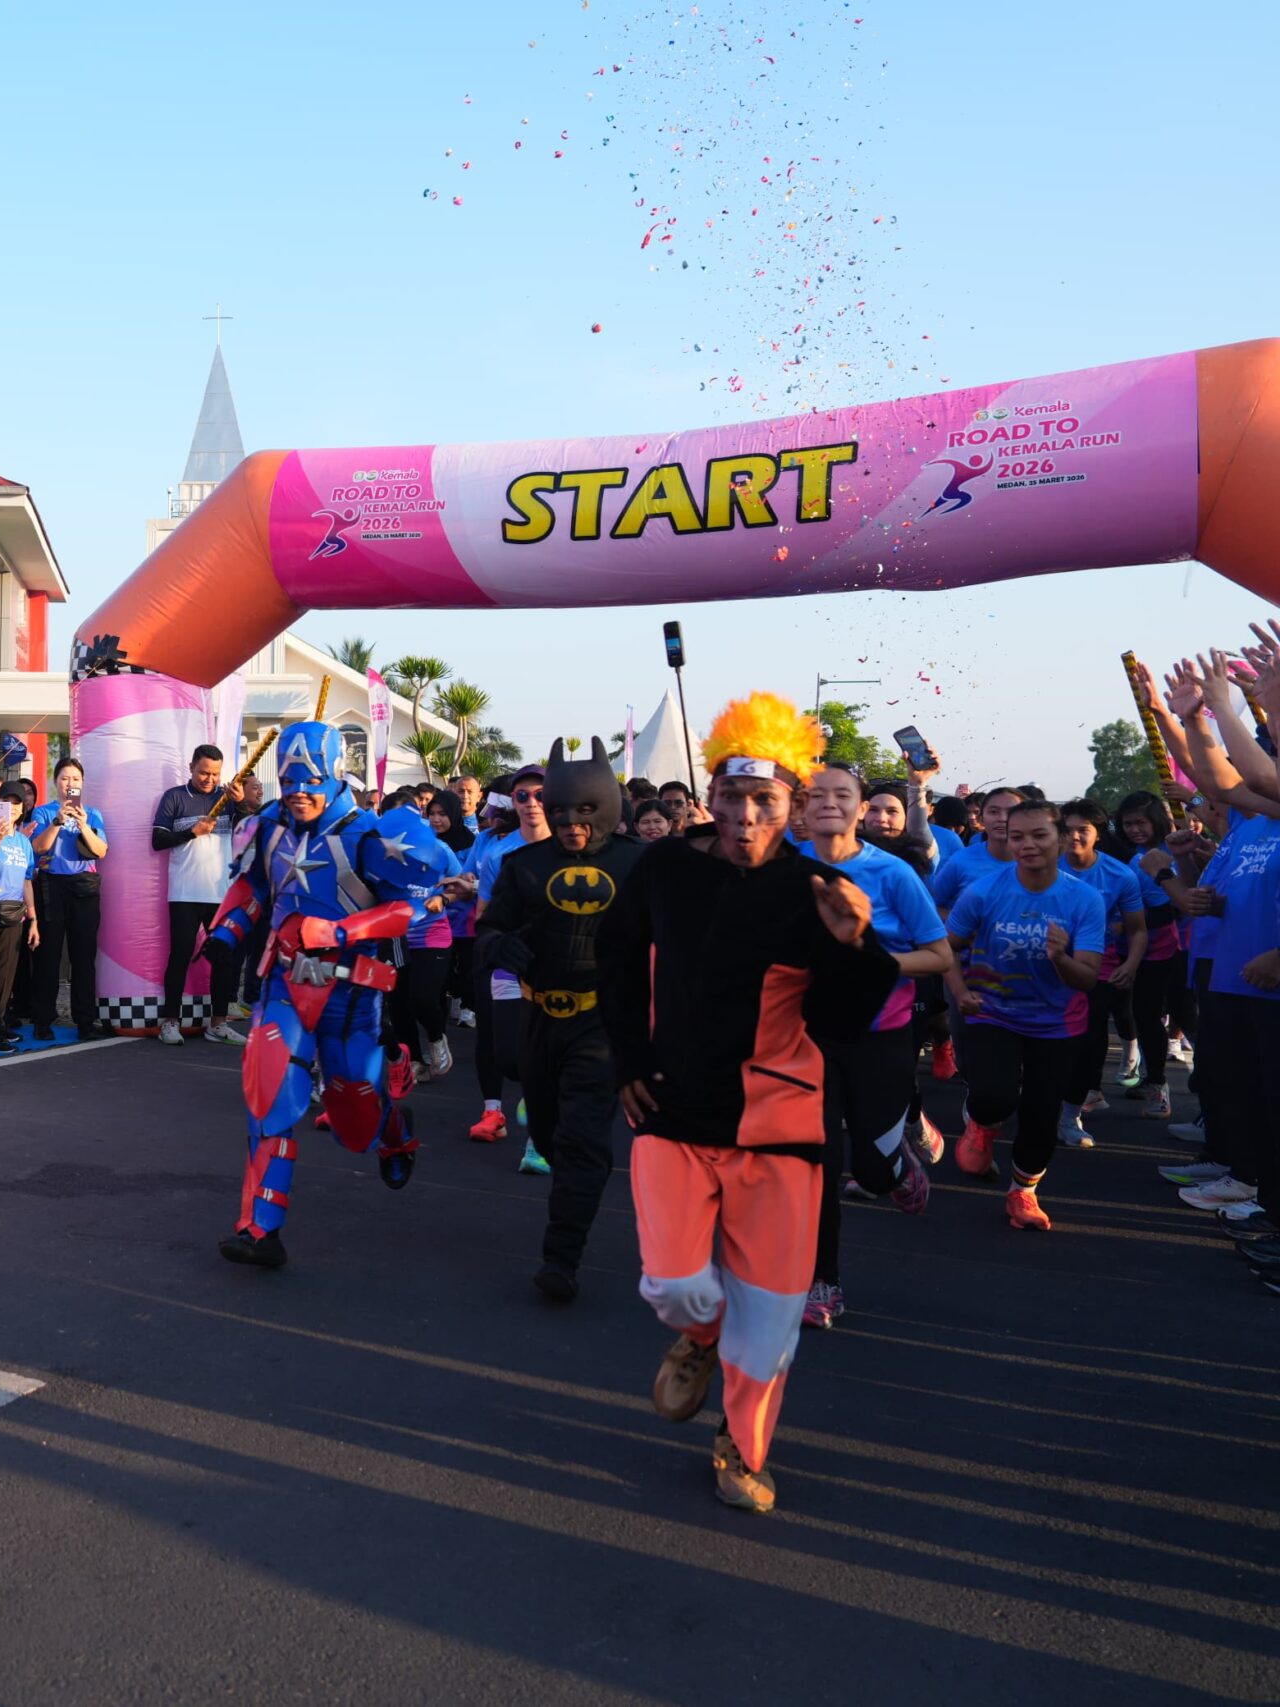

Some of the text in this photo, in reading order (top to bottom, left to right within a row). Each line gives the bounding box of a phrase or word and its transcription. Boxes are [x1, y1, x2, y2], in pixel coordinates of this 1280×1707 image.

[1015, 401, 1070, 416] Kemala
[948, 417, 1079, 447] ROAD TO
[998, 433, 1119, 457] KEMALA RUN
[381, 470, 418, 480] Kemala
[997, 460, 1054, 478] 2026
[332, 485, 421, 501] ROAD TO
[502, 441, 858, 544] START
[364, 501, 445, 513] KEMALA RUN
[362, 518, 400, 530] 2026
[995, 921, 1063, 938] KEMA
